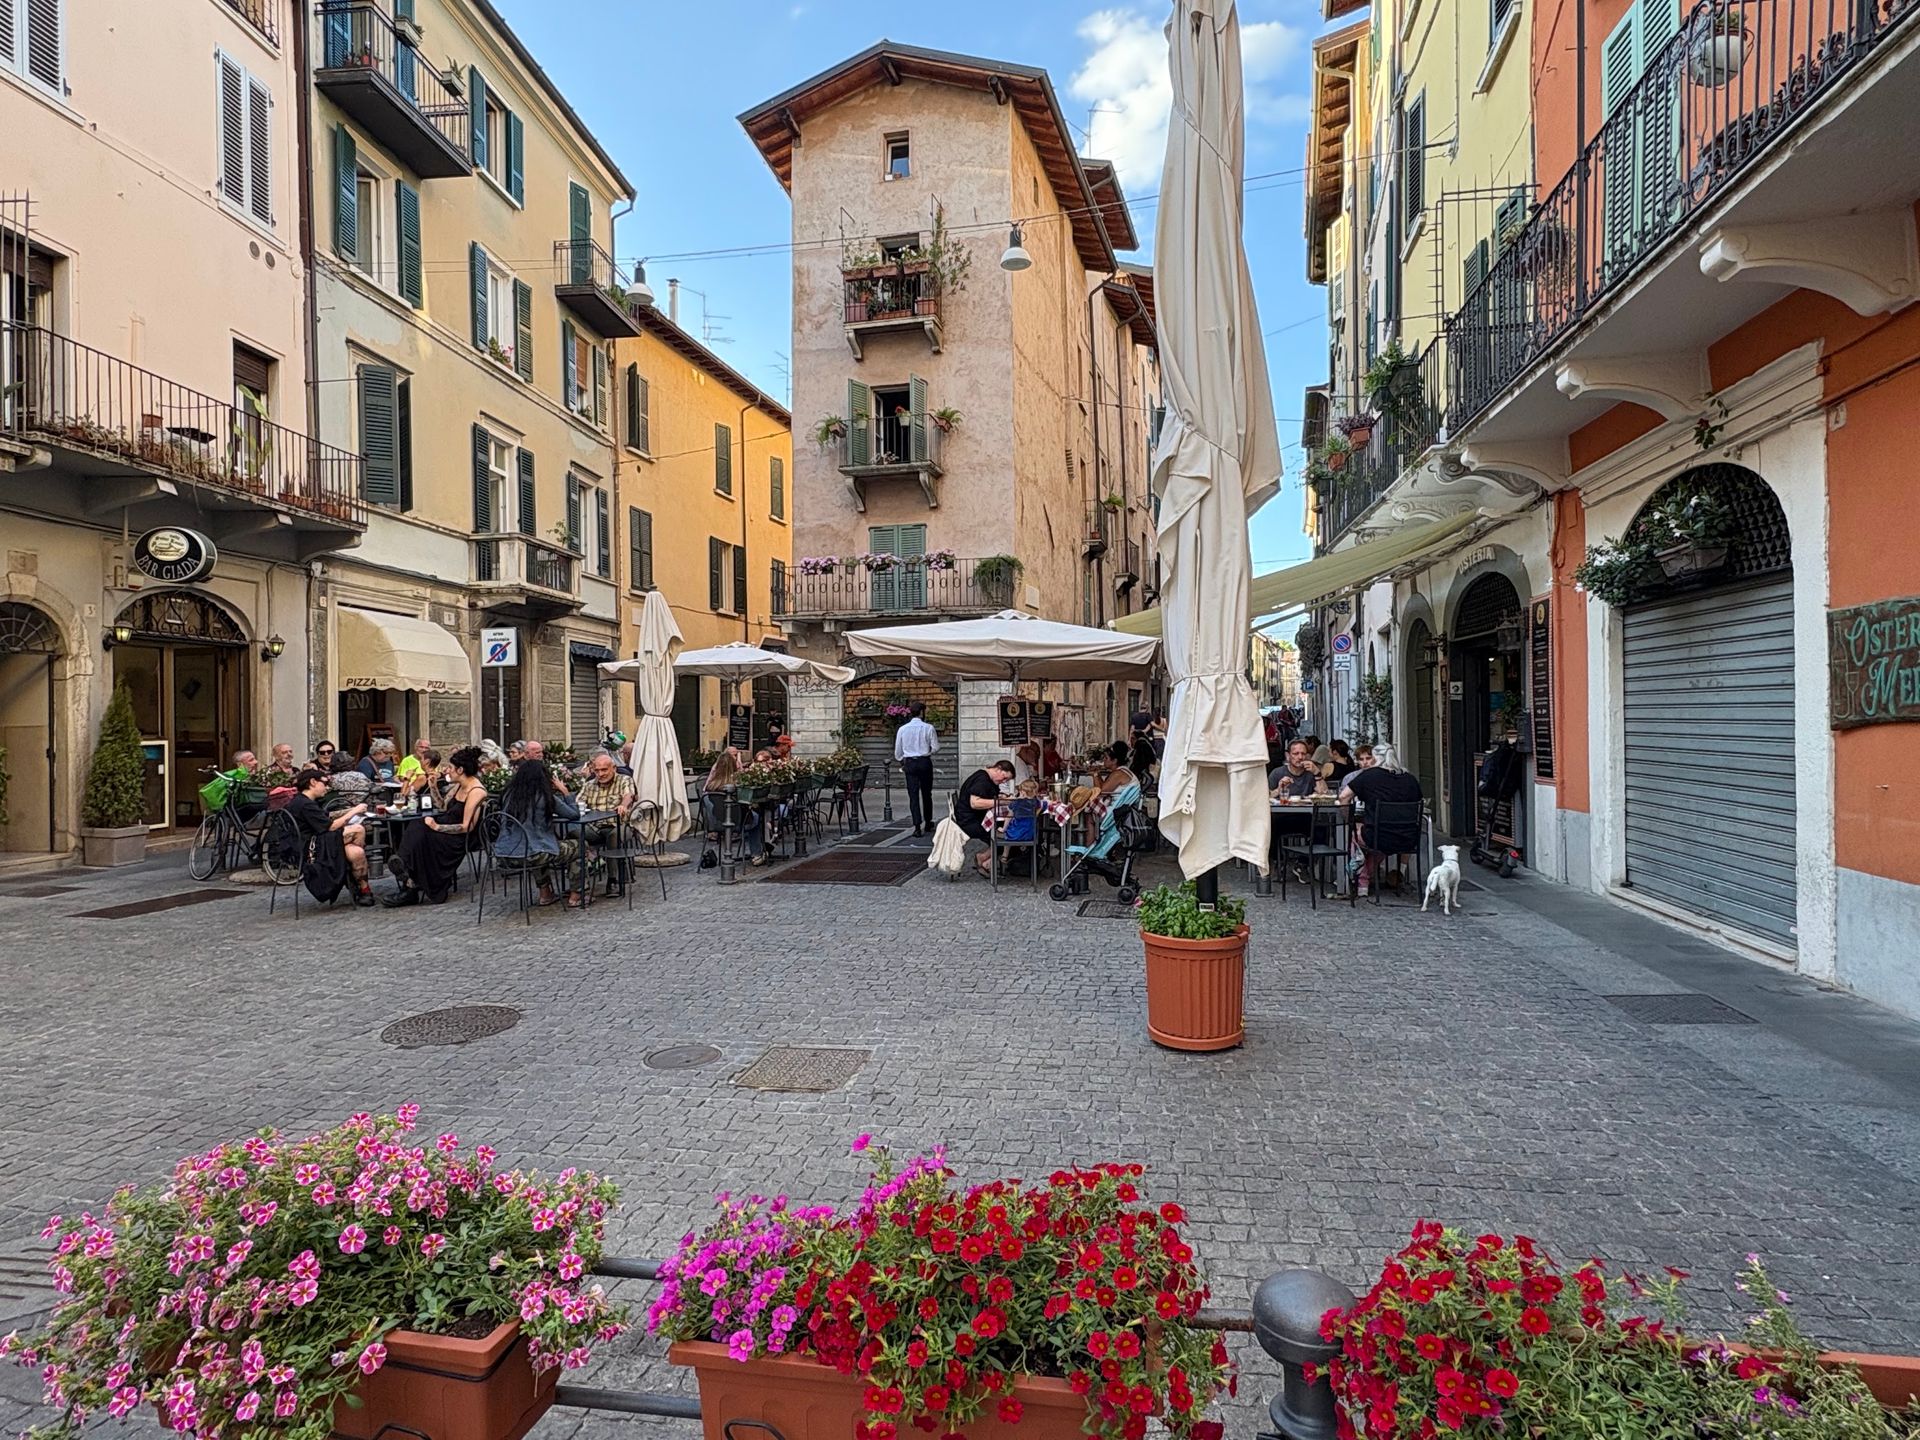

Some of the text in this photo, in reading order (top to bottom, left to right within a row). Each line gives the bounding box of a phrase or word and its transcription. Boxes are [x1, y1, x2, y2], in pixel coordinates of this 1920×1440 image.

[137, 554, 200, 579] BAR GIADA
[1459, 546, 1496, 575] OSTERIA
[345, 677, 377, 687] PIZZA
[426, 680, 446, 689] PIZZA
